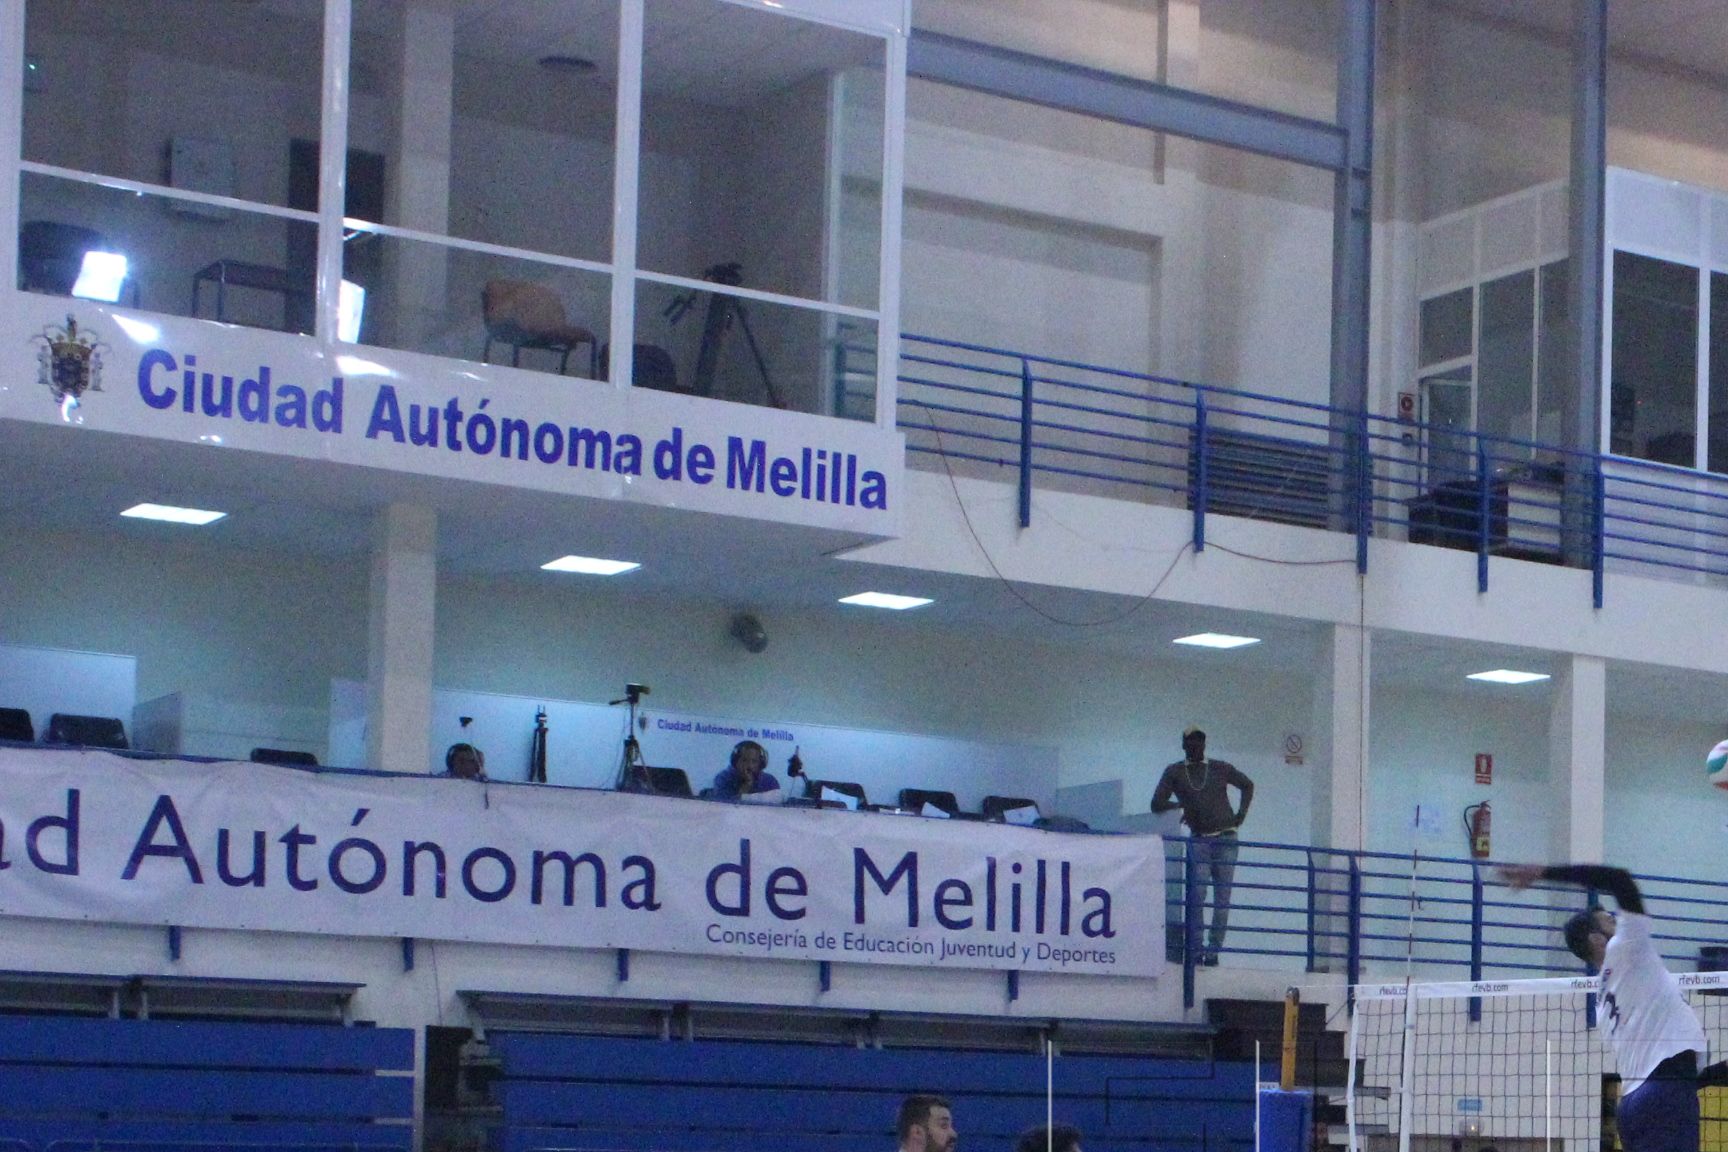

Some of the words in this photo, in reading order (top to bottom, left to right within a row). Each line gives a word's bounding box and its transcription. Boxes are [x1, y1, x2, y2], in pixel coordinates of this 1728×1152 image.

[137, 348, 344, 434] Ciudad
[365, 384, 643, 477] Autónoma
[653, 427, 716, 485] de
[726, 436, 888, 511] Melilla
[657, 719, 692, 732] Ciudad
[747, 727, 759, 738] de
[762, 728, 794, 742] Melilla
[120, 794, 662, 912] Autónoma
[705, 838, 808, 922] de
[853, 847, 1117, 939] Melilla
[706, 923, 808, 948] Consejería
[815, 931, 837, 950] de
[844, 932, 935, 957] Educación
[940, 938, 1016, 961] Juventud
[1021, 945, 1031, 963] y
[1037, 943, 1116, 967] Deportes
[1571, 979, 1600, 989] rfevb.c
[1678, 974, 1721, 985] rfevb.com
